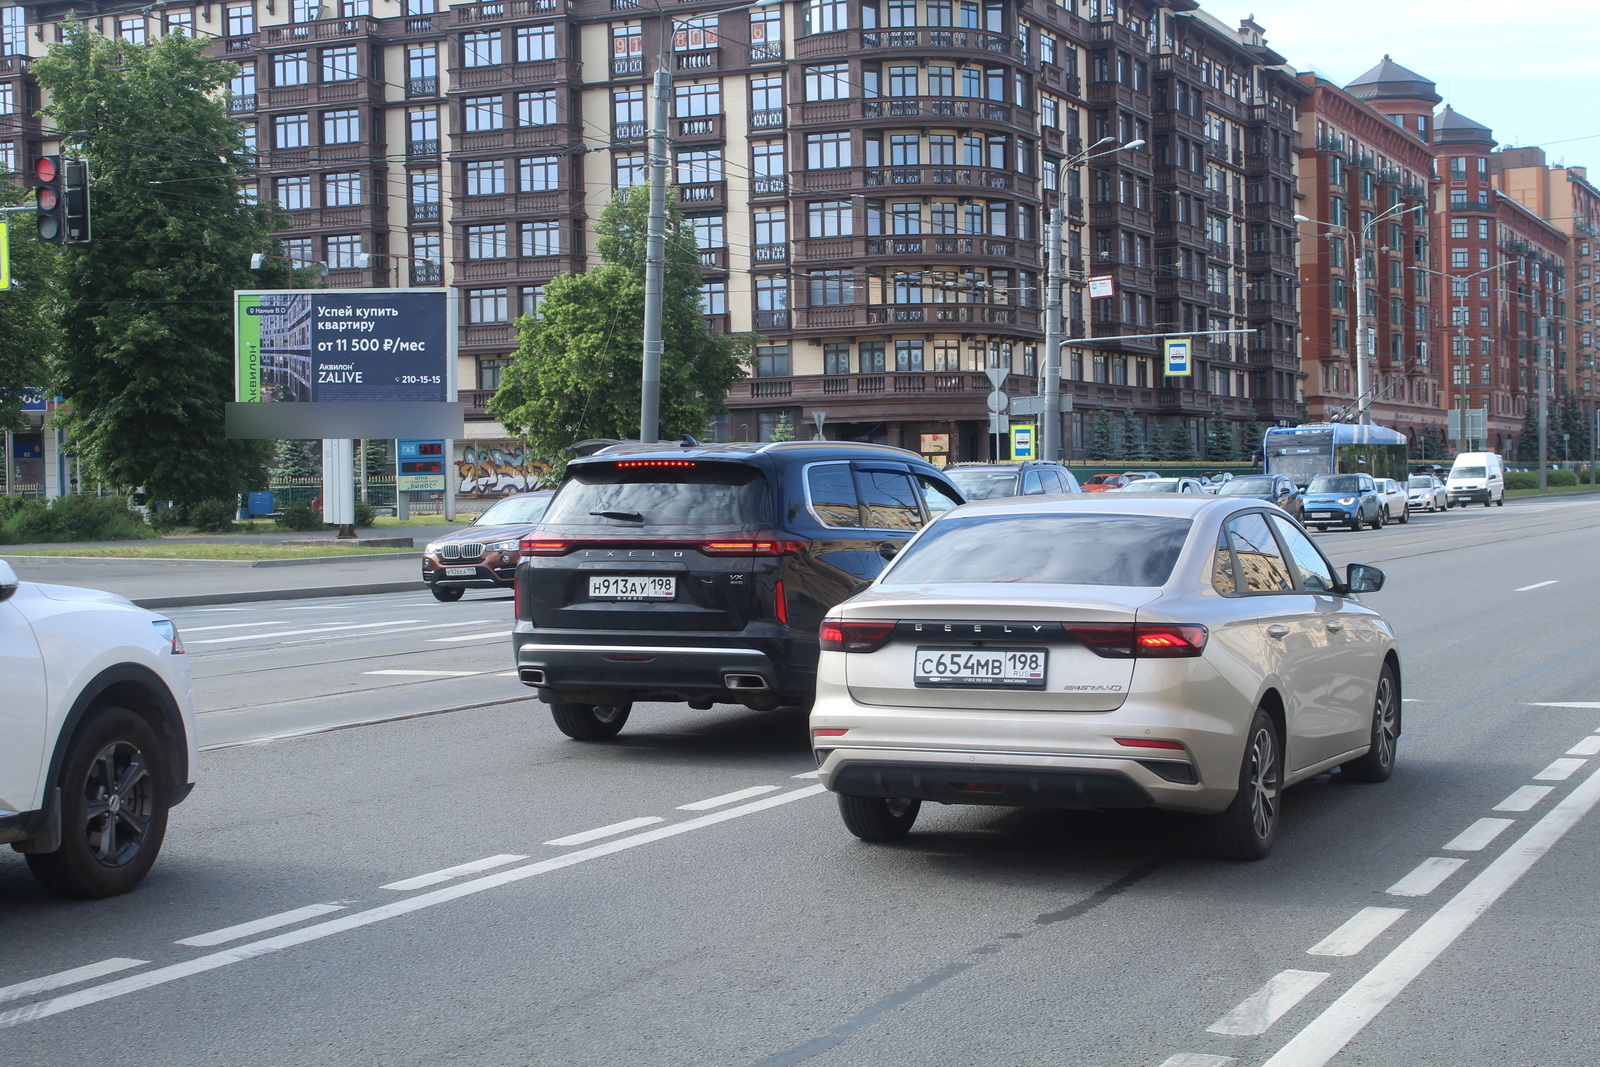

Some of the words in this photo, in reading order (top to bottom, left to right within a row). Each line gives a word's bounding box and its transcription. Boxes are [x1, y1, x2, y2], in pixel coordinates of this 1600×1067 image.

[318, 306, 352, 318] Успей
[356, 308, 398, 319] купить
[318, 321, 375, 332] квартиру
[318, 342, 334, 351] от
[336, 339, 347, 350] 11
[351, 338, 380, 351] 500
[318, 372, 363, 384] ZALIVE
[402, 376, 440, 384] 210-15-15
[593, 579, 647, 594] Н913АУ
[650, 578, 671, 590] 198
[915, 624, 1042, 632] GEELY
[922, 654, 1002, 676] С654МВ
[1008, 654, 1038, 670] 198
